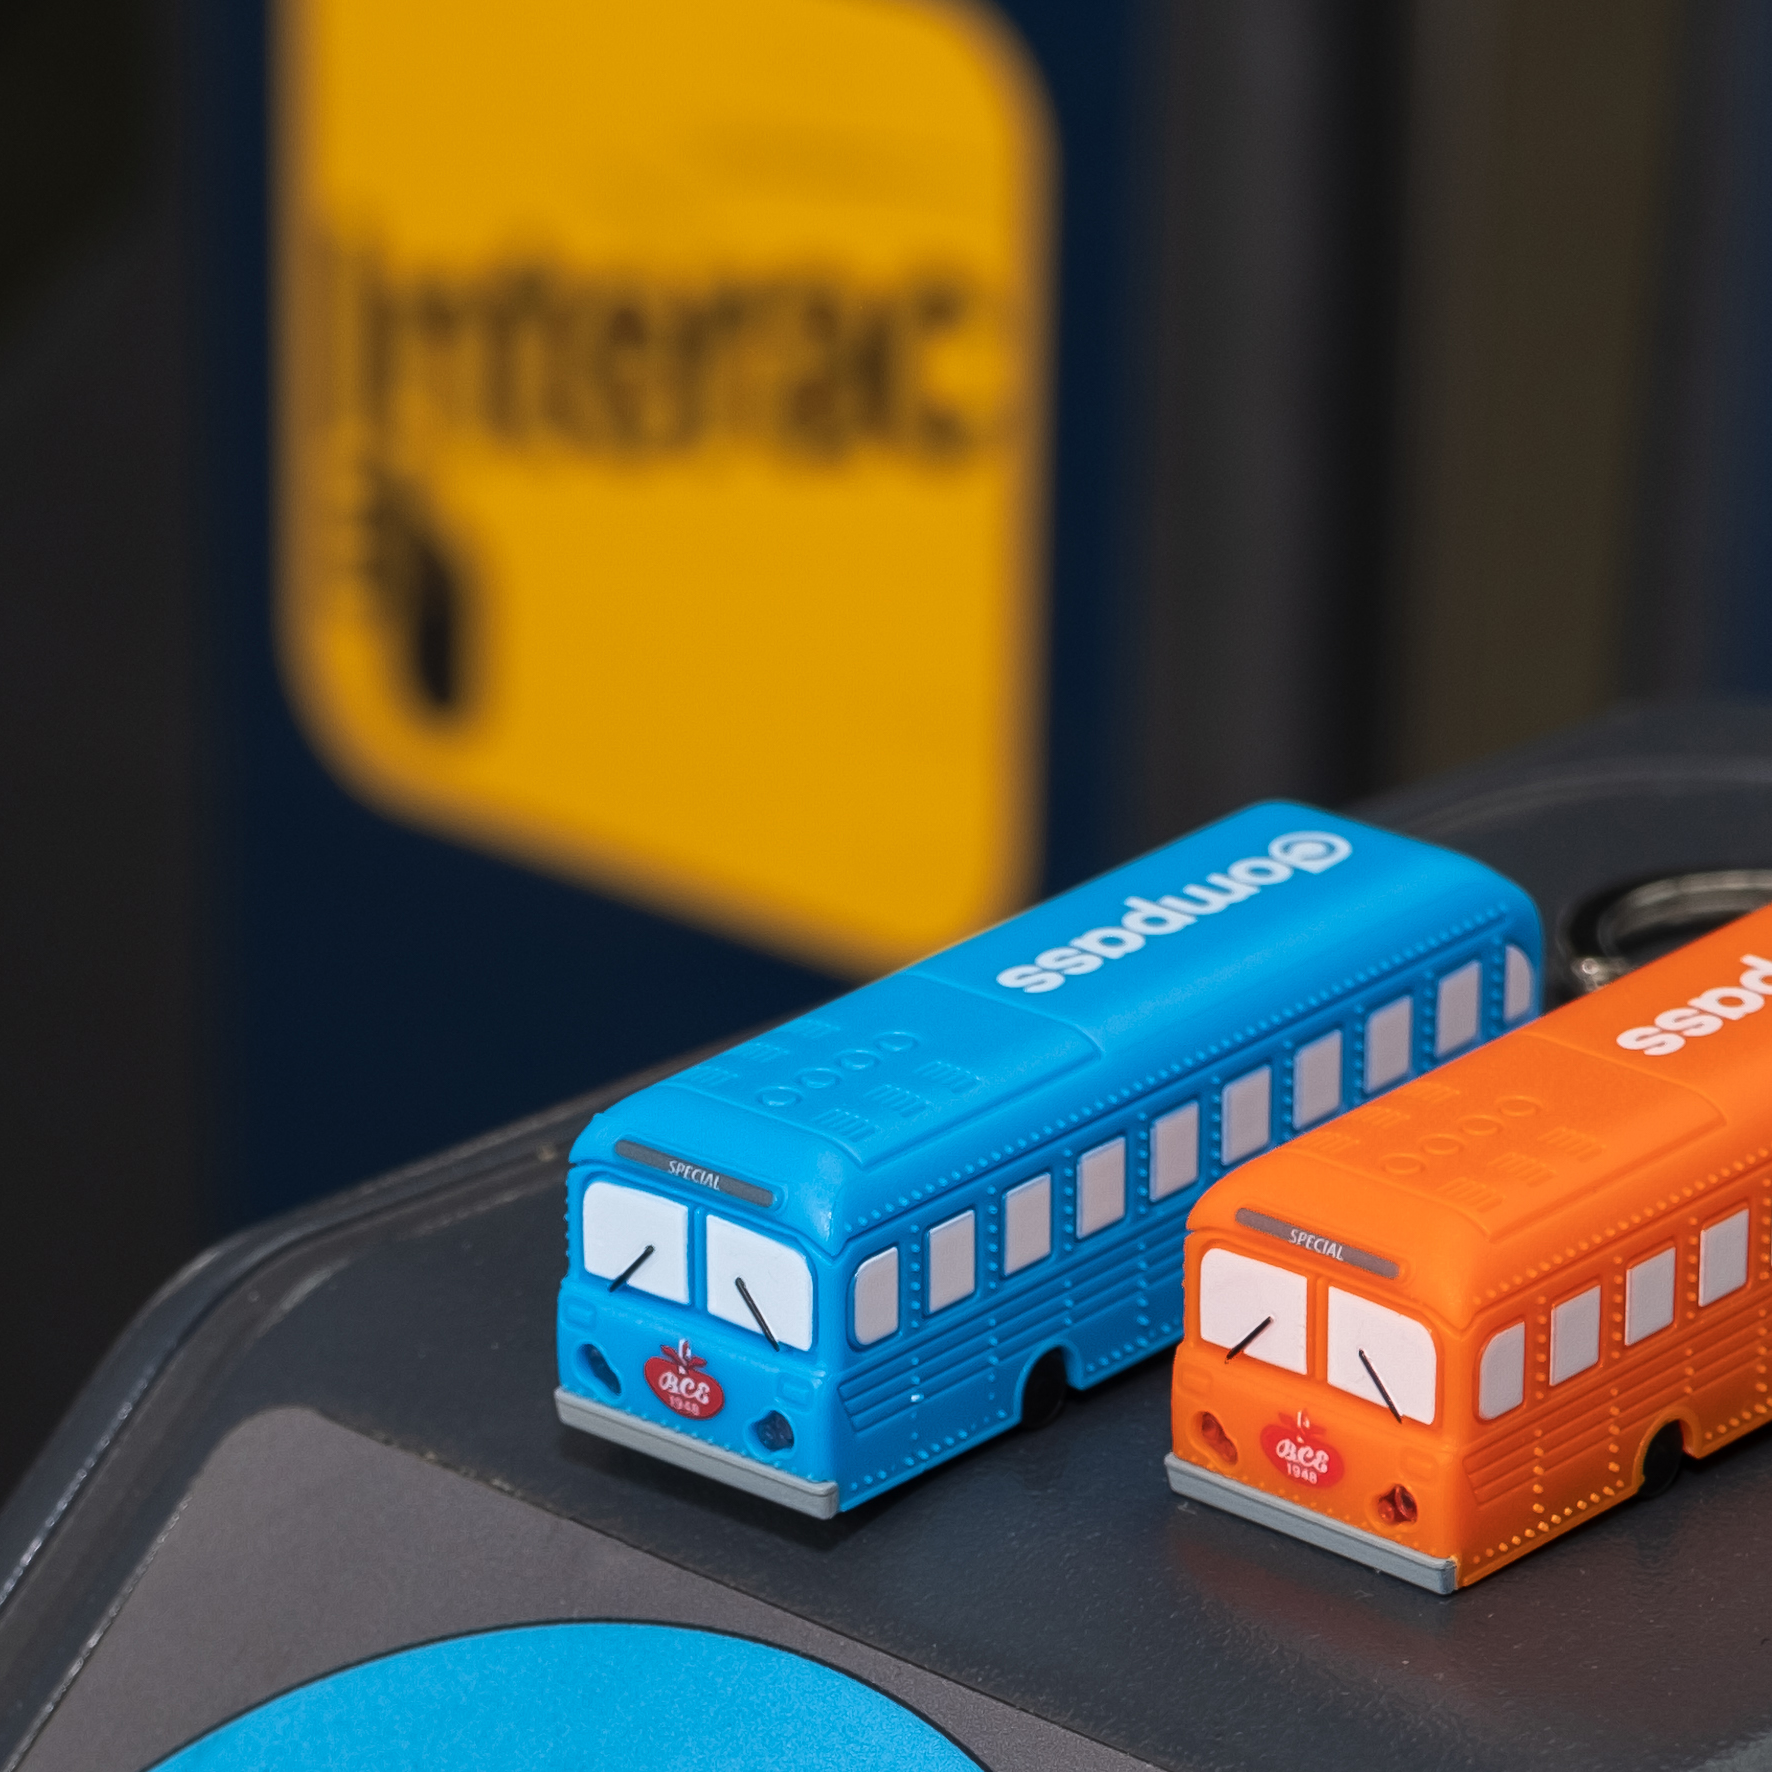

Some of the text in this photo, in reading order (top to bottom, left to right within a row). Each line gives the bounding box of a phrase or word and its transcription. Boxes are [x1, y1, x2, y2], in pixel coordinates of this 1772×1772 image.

[320, 215, 993, 474] Interac
[995, 830, 1353, 994] Compass
[667, 1159, 721, 1191] SPECIAL
[1287, 1228, 1345, 1262] SPECIAL
[1286, 1462, 1318, 1485] 1948
